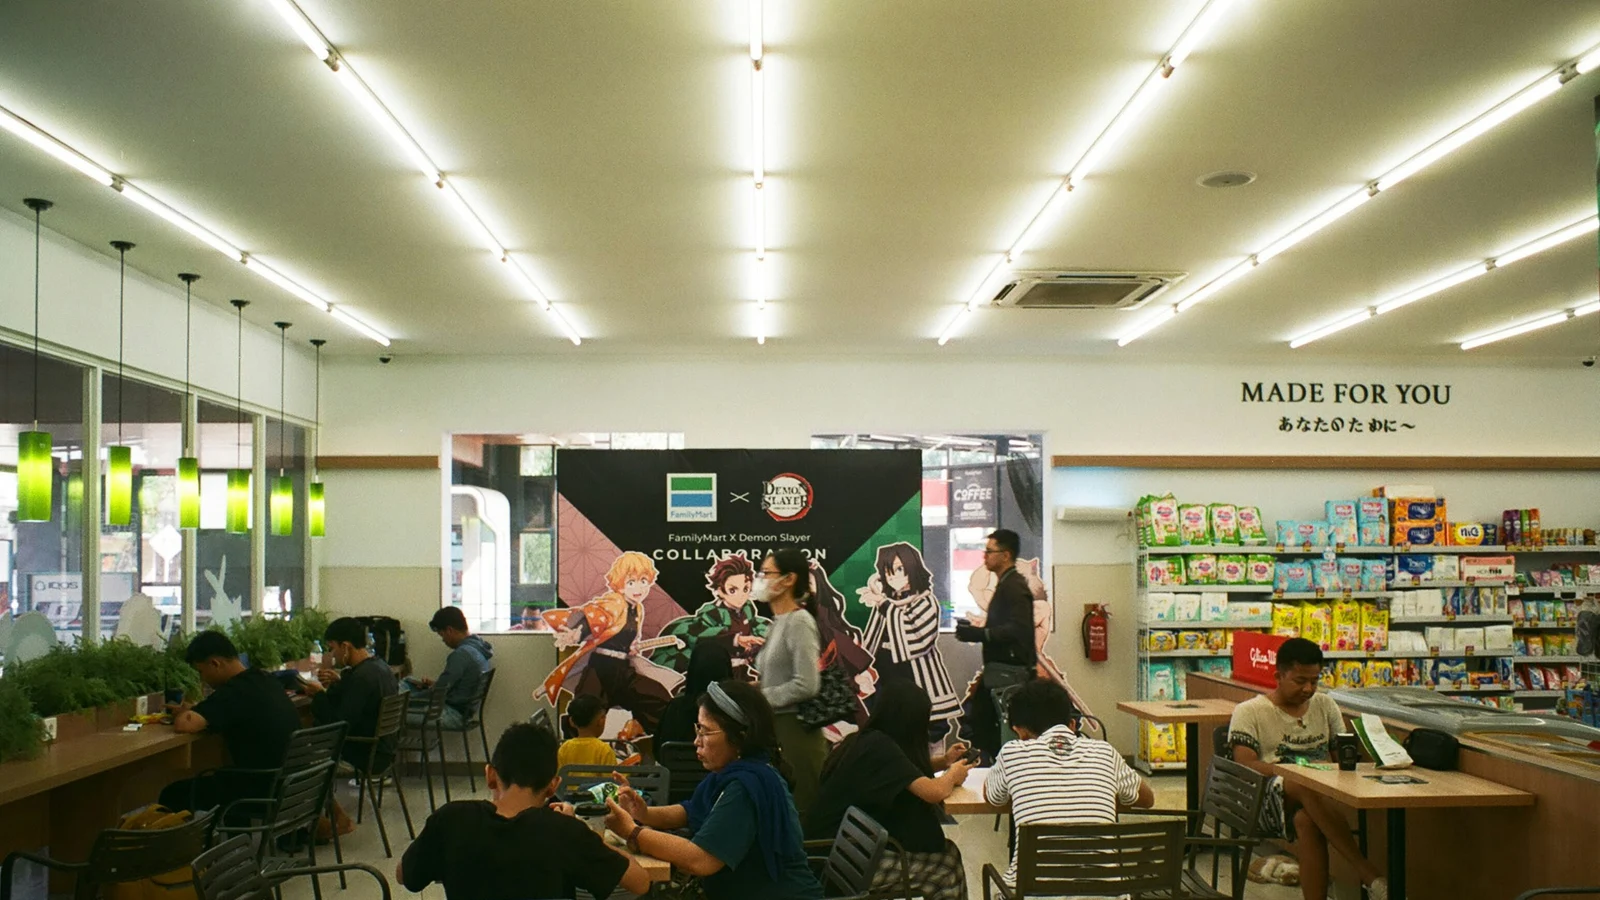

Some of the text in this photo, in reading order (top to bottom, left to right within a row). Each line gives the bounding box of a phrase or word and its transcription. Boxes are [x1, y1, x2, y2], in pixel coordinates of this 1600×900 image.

[1241, 382, 1452, 405] MADE FOR YOU
[762, 481, 808, 496] DEMON
[953, 487, 993, 501] COFFEE
[761, 494, 810, 510] SLAYER
[670, 511, 714, 519] FamilyMart
[668, 533, 811, 544] FamilyMart X Demon Slayer
[48, 581, 79, 590] IQOS
